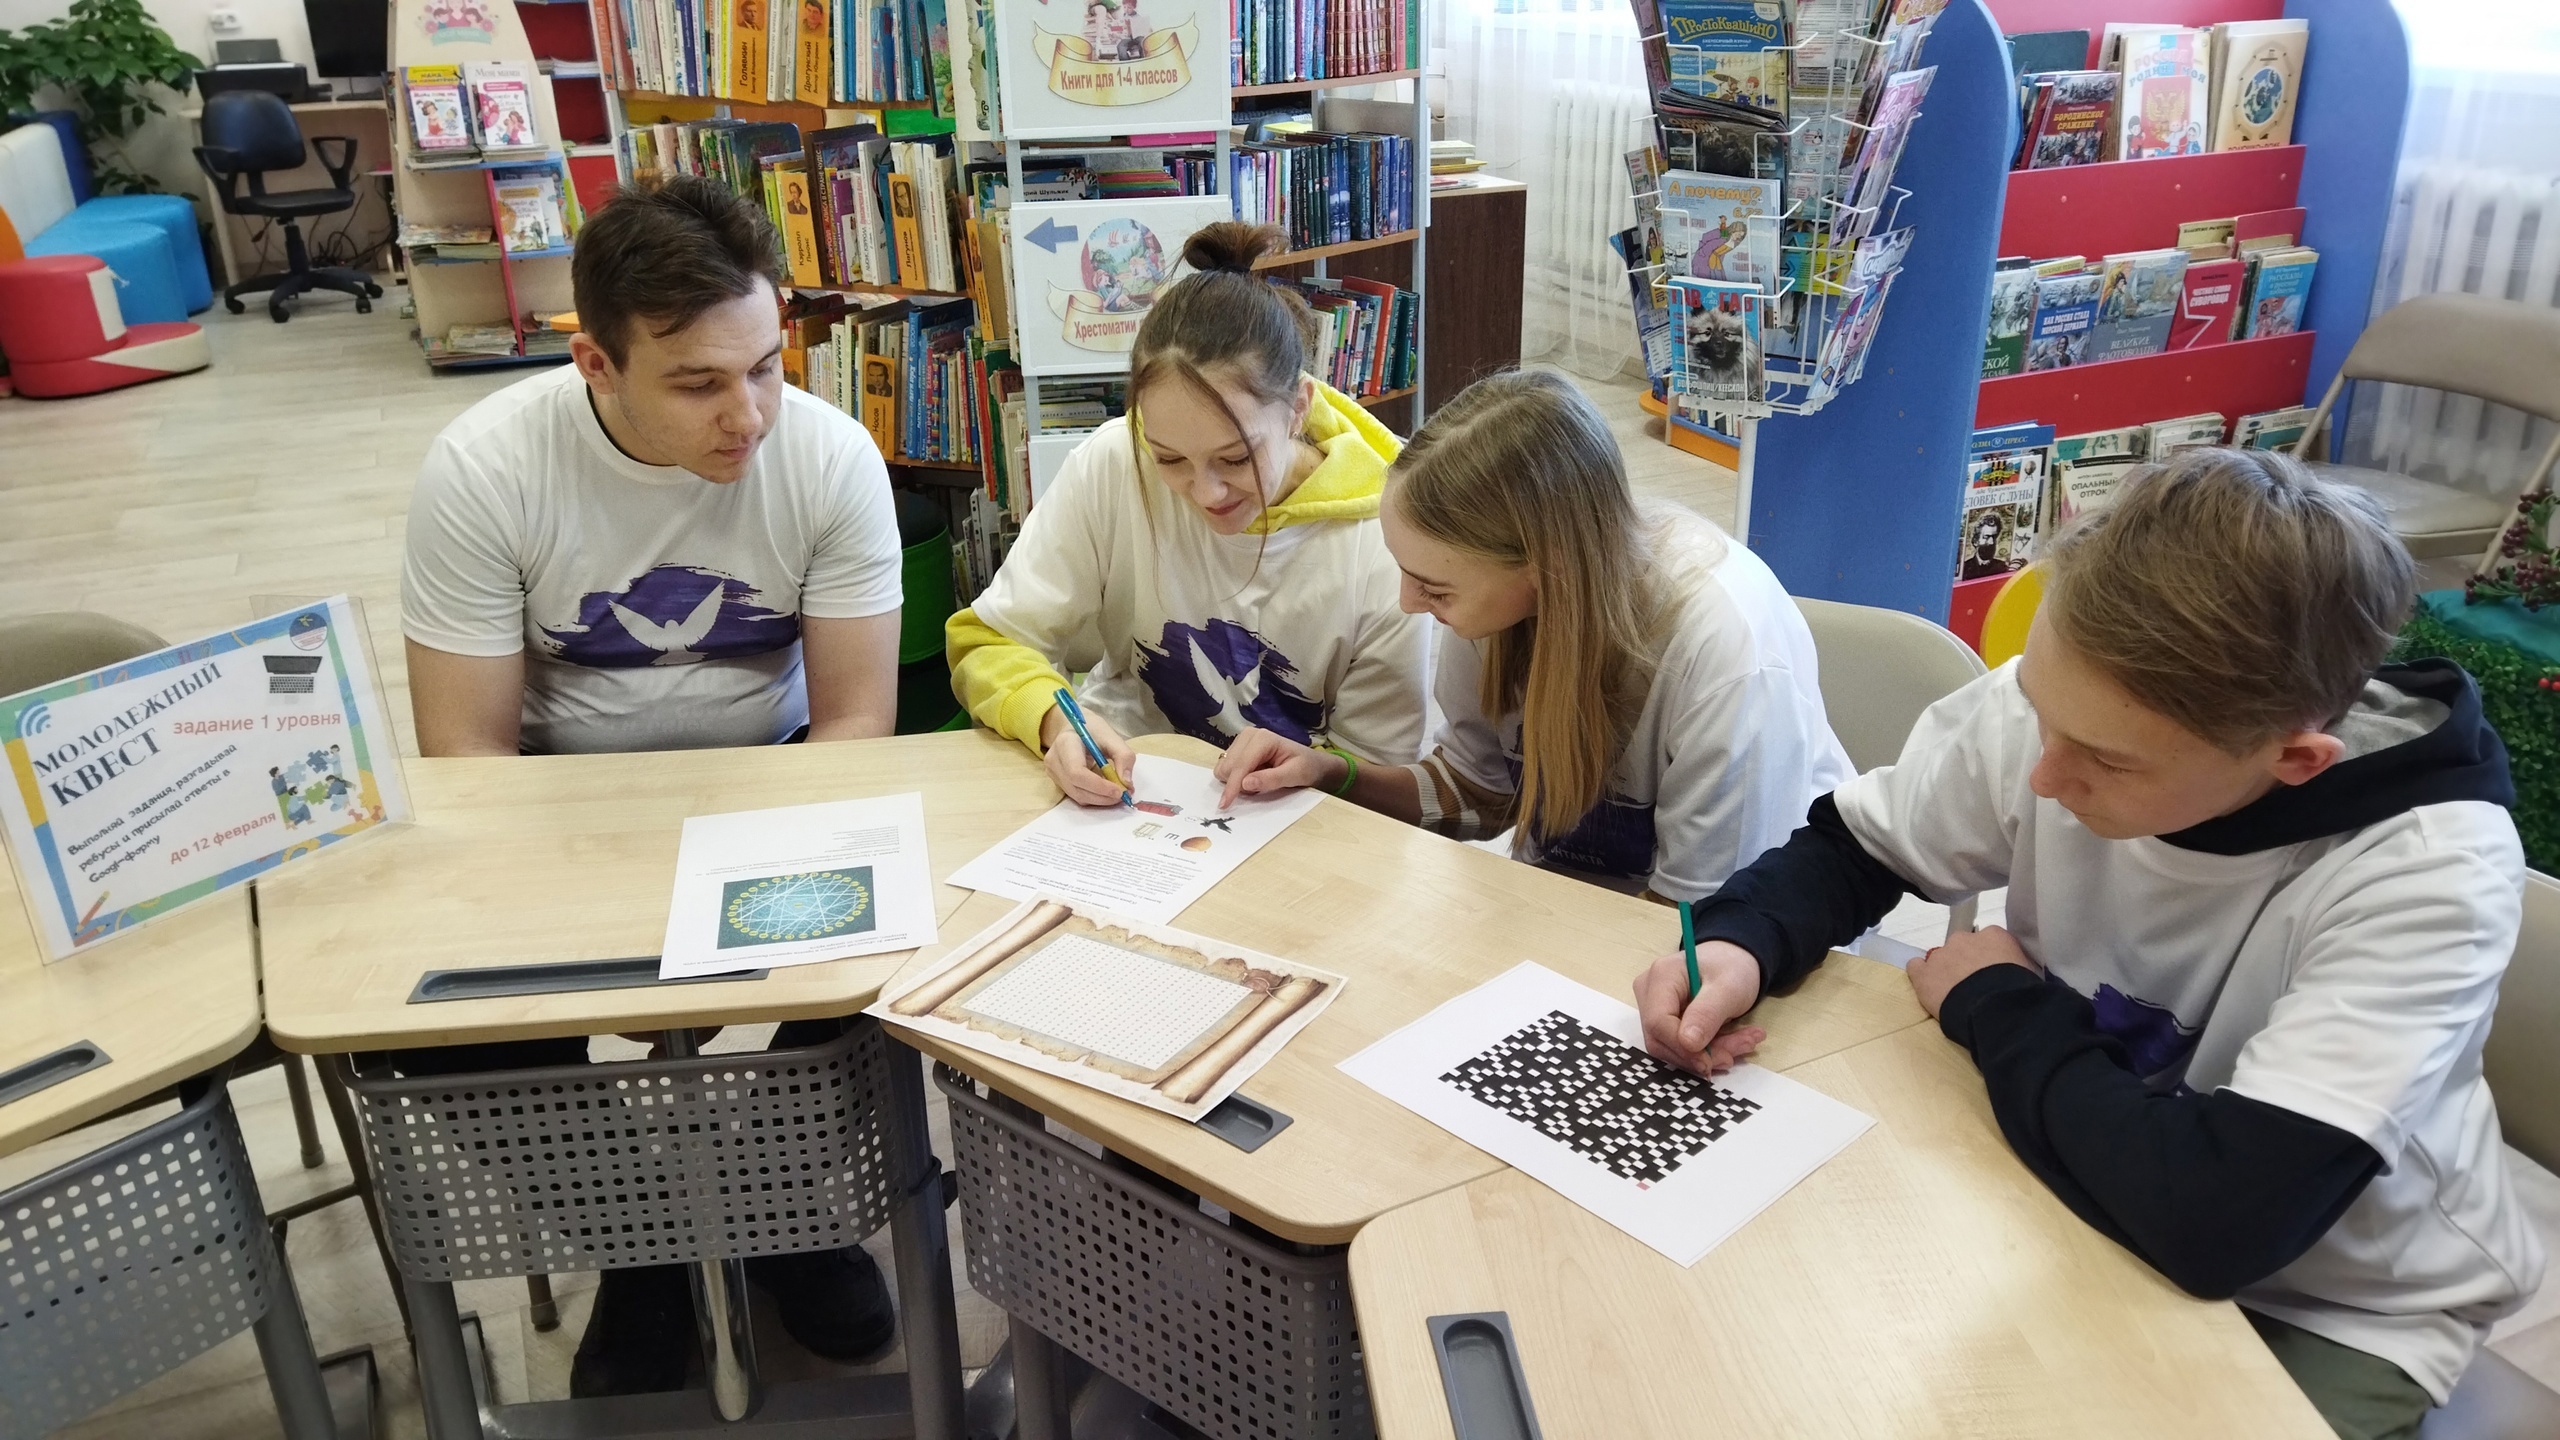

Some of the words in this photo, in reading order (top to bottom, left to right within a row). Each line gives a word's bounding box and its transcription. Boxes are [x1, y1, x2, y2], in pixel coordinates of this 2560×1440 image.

[740, 41, 748, 86] Голявкин
[1060, 71, 1092, 90] Книги
[1096, 73, 1114, 91] для
[1117, 66, 1132, 87] 1-4
[1135, 69, 1178, 85] классов
[2053, 110, 2104, 121] БОРОДИНСКОЕ
[2057, 120, 2095, 130] СРАЖЕНИЕ
[1668, 181, 1681, 197] А
[1685, 186, 1762, 206] почему?
[1074, 320, 1137, 342] Хрестоматии
[1981, 354, 2010, 370] СКОЙ
[1963, 493, 1997, 508] ЕЛОВЕК
[2006, 489, 2034, 503] ЛУНЫ
[2080, 489, 2108, 498] ОТРОК
[31, 660, 222, 778] МОЛОДЕЖНЫЙ
[173, 718, 254, 735] задание
[261, 715, 269, 729] 1
[276, 713, 341, 731] уровня
[49, 727, 161, 807] КВЕСТ
[67, 817, 125, 856] Выполняй
[129, 786, 176, 818] задания,
[177, 744, 238, 791] разгадывай
[79, 841, 120, 872] ребусы
[122, 834, 130, 843] и
[132, 799, 183, 839] присылай
[185, 775, 221, 803] ответы
[222, 768, 231, 778] в
[170, 847, 190, 865] до
[192, 838, 210, 852] 12
[213, 812, 276, 847] февраля
[1550, 844, 1607, 868] НТАКТА
